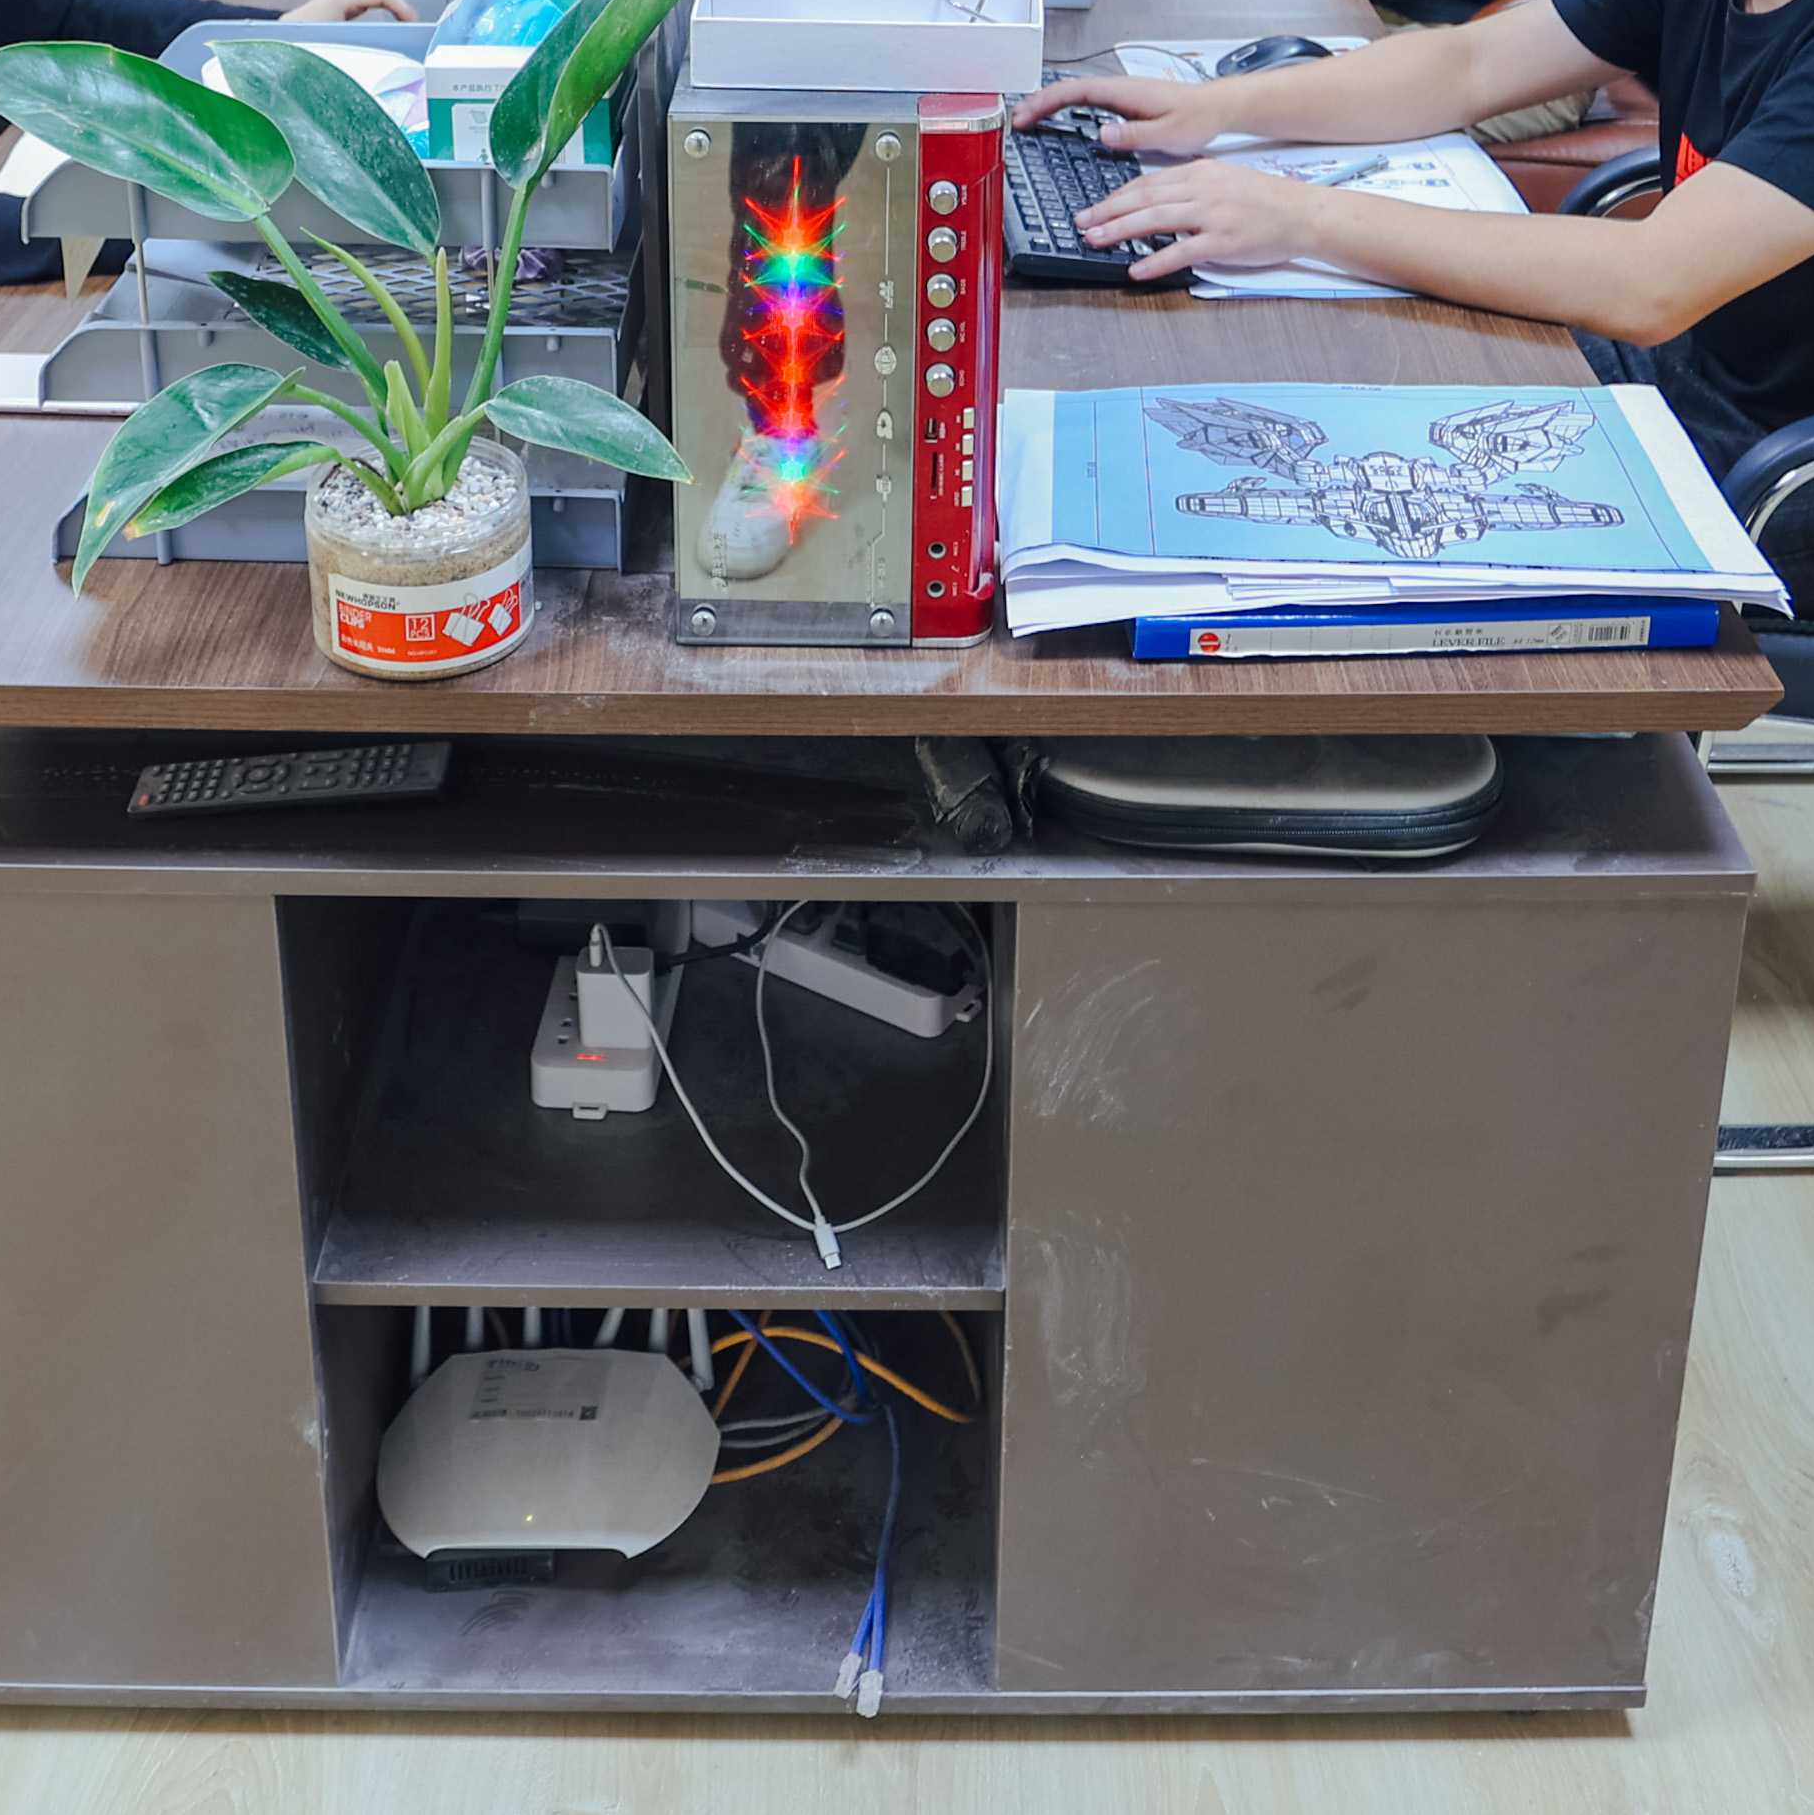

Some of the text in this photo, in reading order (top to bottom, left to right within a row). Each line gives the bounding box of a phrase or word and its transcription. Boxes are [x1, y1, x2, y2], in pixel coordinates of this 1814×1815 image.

[411, 618, 429, 631] 12
[1433, 637, 1475, 647] LEVER
[1477, 636, 1506, 647] FILE
